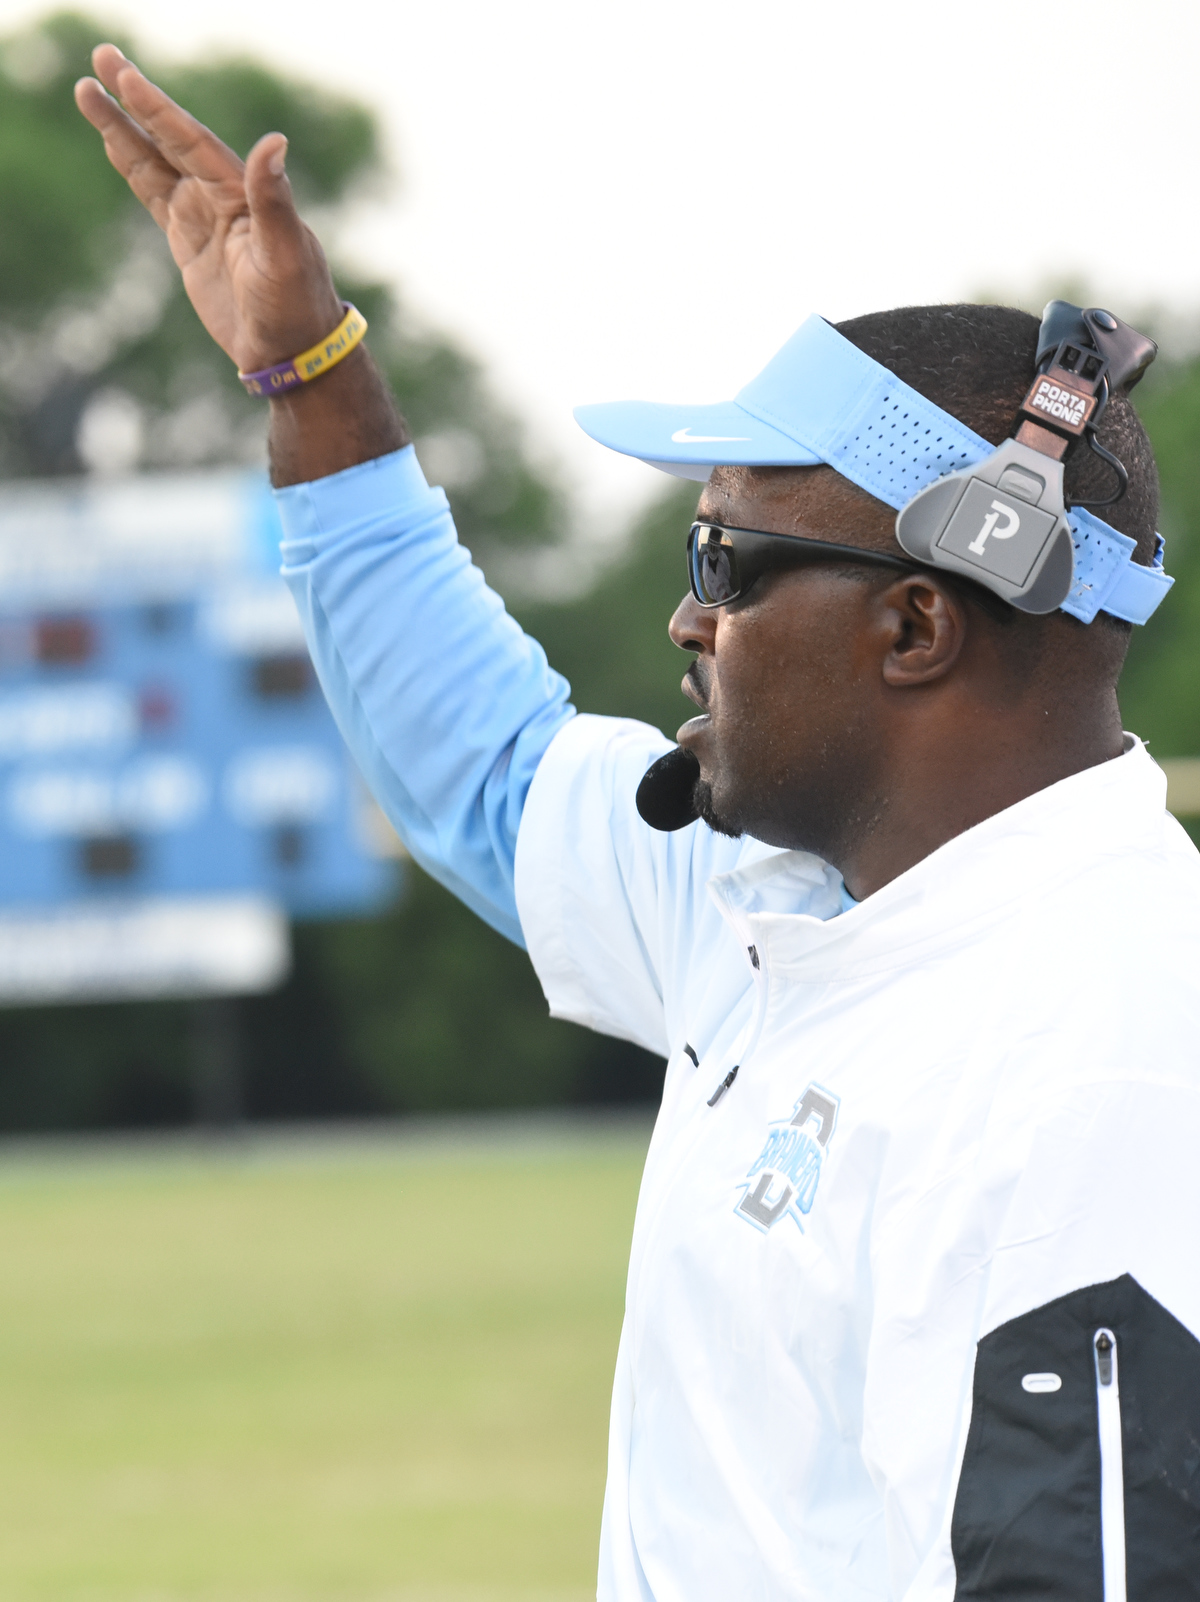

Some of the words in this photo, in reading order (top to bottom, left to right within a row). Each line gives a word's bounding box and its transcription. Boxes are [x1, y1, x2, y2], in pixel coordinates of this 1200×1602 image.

[1032, 393, 1083, 426] PHONE
[1038, 381, 1086, 414] PORTA
[968, 499, 1020, 556] P
